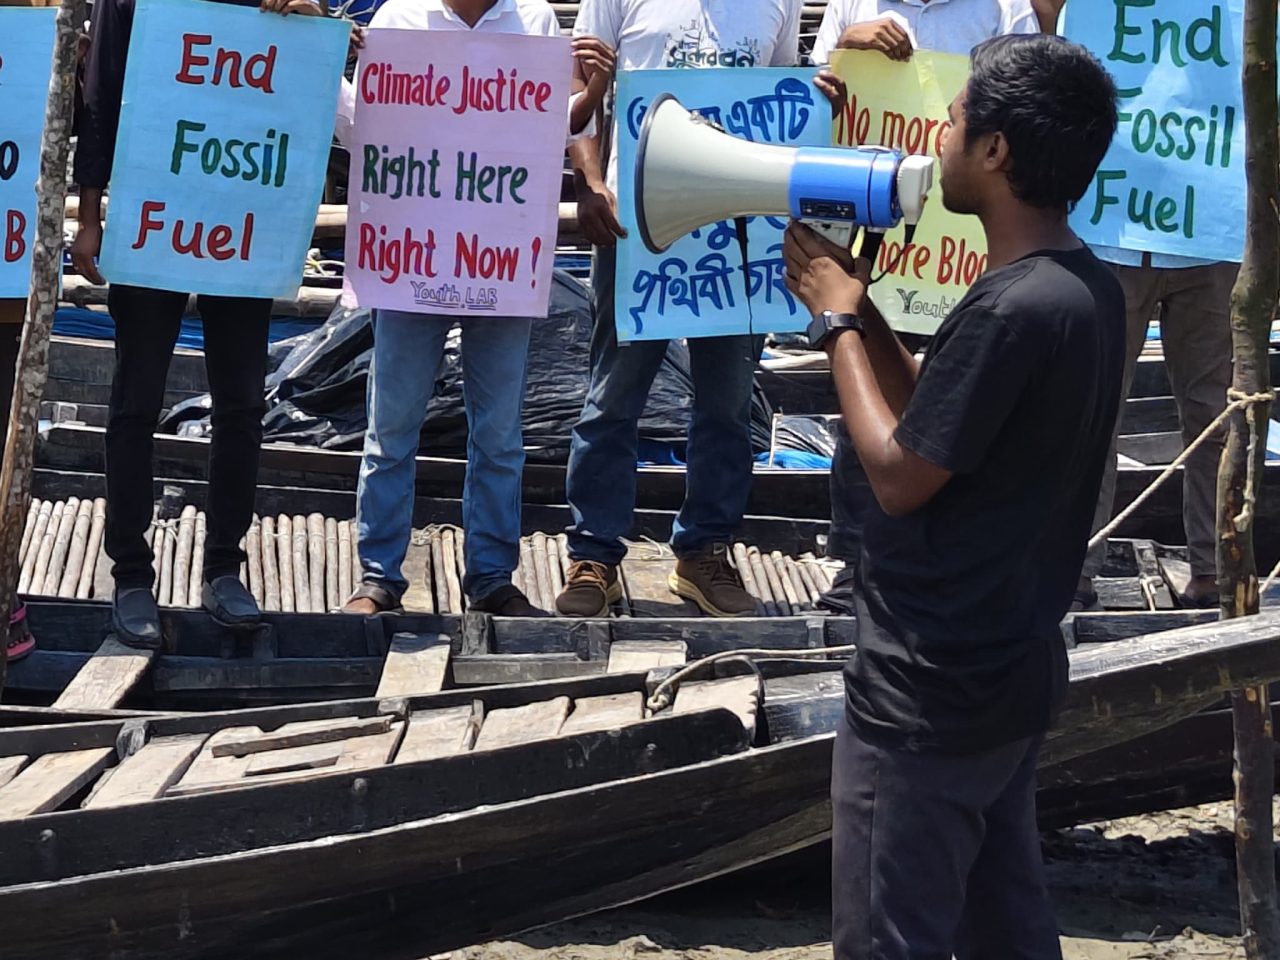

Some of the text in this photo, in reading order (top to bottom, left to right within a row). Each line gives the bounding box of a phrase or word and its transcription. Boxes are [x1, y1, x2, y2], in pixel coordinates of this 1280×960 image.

[176, 33, 277, 93] End
[361, 62, 552, 115] Climate Justice
[726, 77, 814, 143] একটি
[837, 94, 870, 147] No
[170, 119, 289, 187] Fossil
[361, 144, 528, 204] Right Here
[131, 200, 254, 261] Fuel
[1089, 169, 1194, 239] Fuel
[4, 209, 27, 263] B
[358, 222, 439, 284] Right
[936, 235, 988, 286] Bloo
[629, 253, 735, 335] পৃথিবী
[896, 288, 956, 319] Yout
